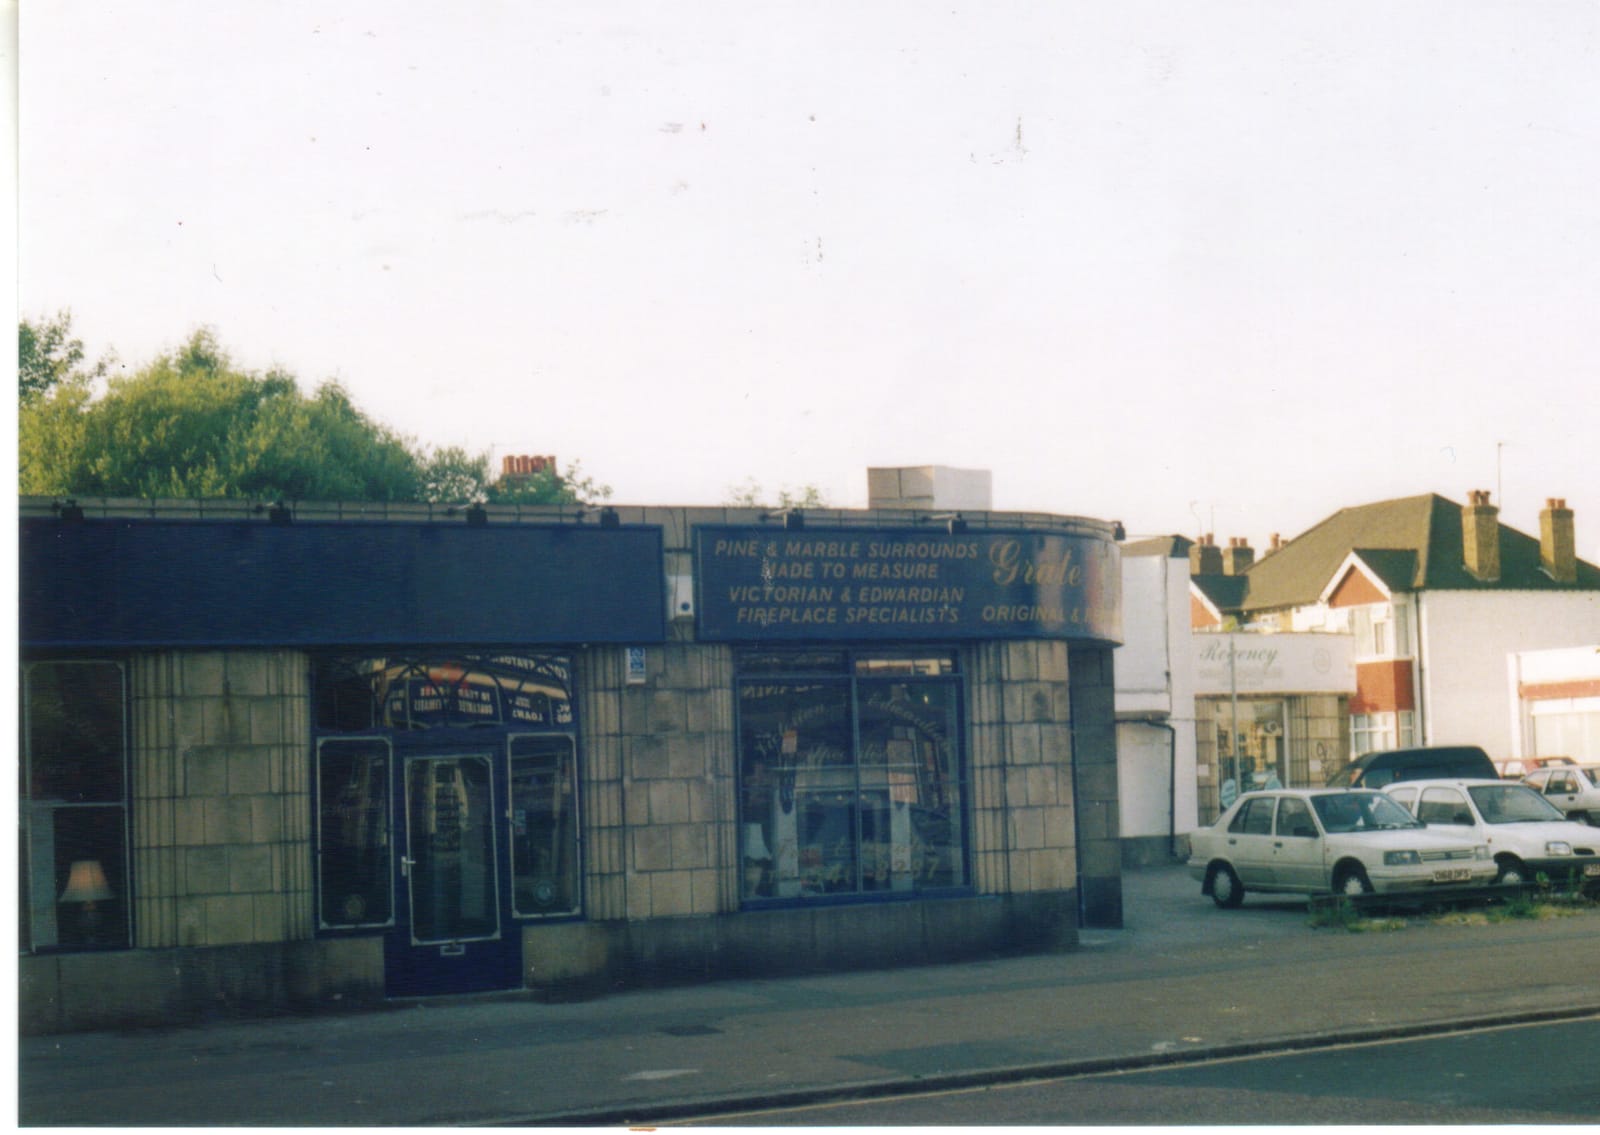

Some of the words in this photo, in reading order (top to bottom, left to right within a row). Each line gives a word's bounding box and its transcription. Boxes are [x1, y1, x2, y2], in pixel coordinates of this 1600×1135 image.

[715, 541, 758, 557] PINE
[766, 541, 777, 557] &
[785, 541, 860, 558] MARBLE
[868, 541, 978, 559] SURROUNDS
[762, 563, 814, 579] MADE
[822, 563, 845, 579] TO
[853, 563, 938, 579] MEASURE
[990, 541, 1079, 585] Grate
[729, 586, 833, 603] VICTORIAN
[841, 586, 852, 602] &
[859, 586, 964, 604] EDWARDIAN
[737, 607, 837, 624] FIREPLACE
[846, 606, 959, 624] SPECIALISTS
[982, 606, 1064, 623] ORIGINAL
[1200, 640, 1276, 667] Regency
